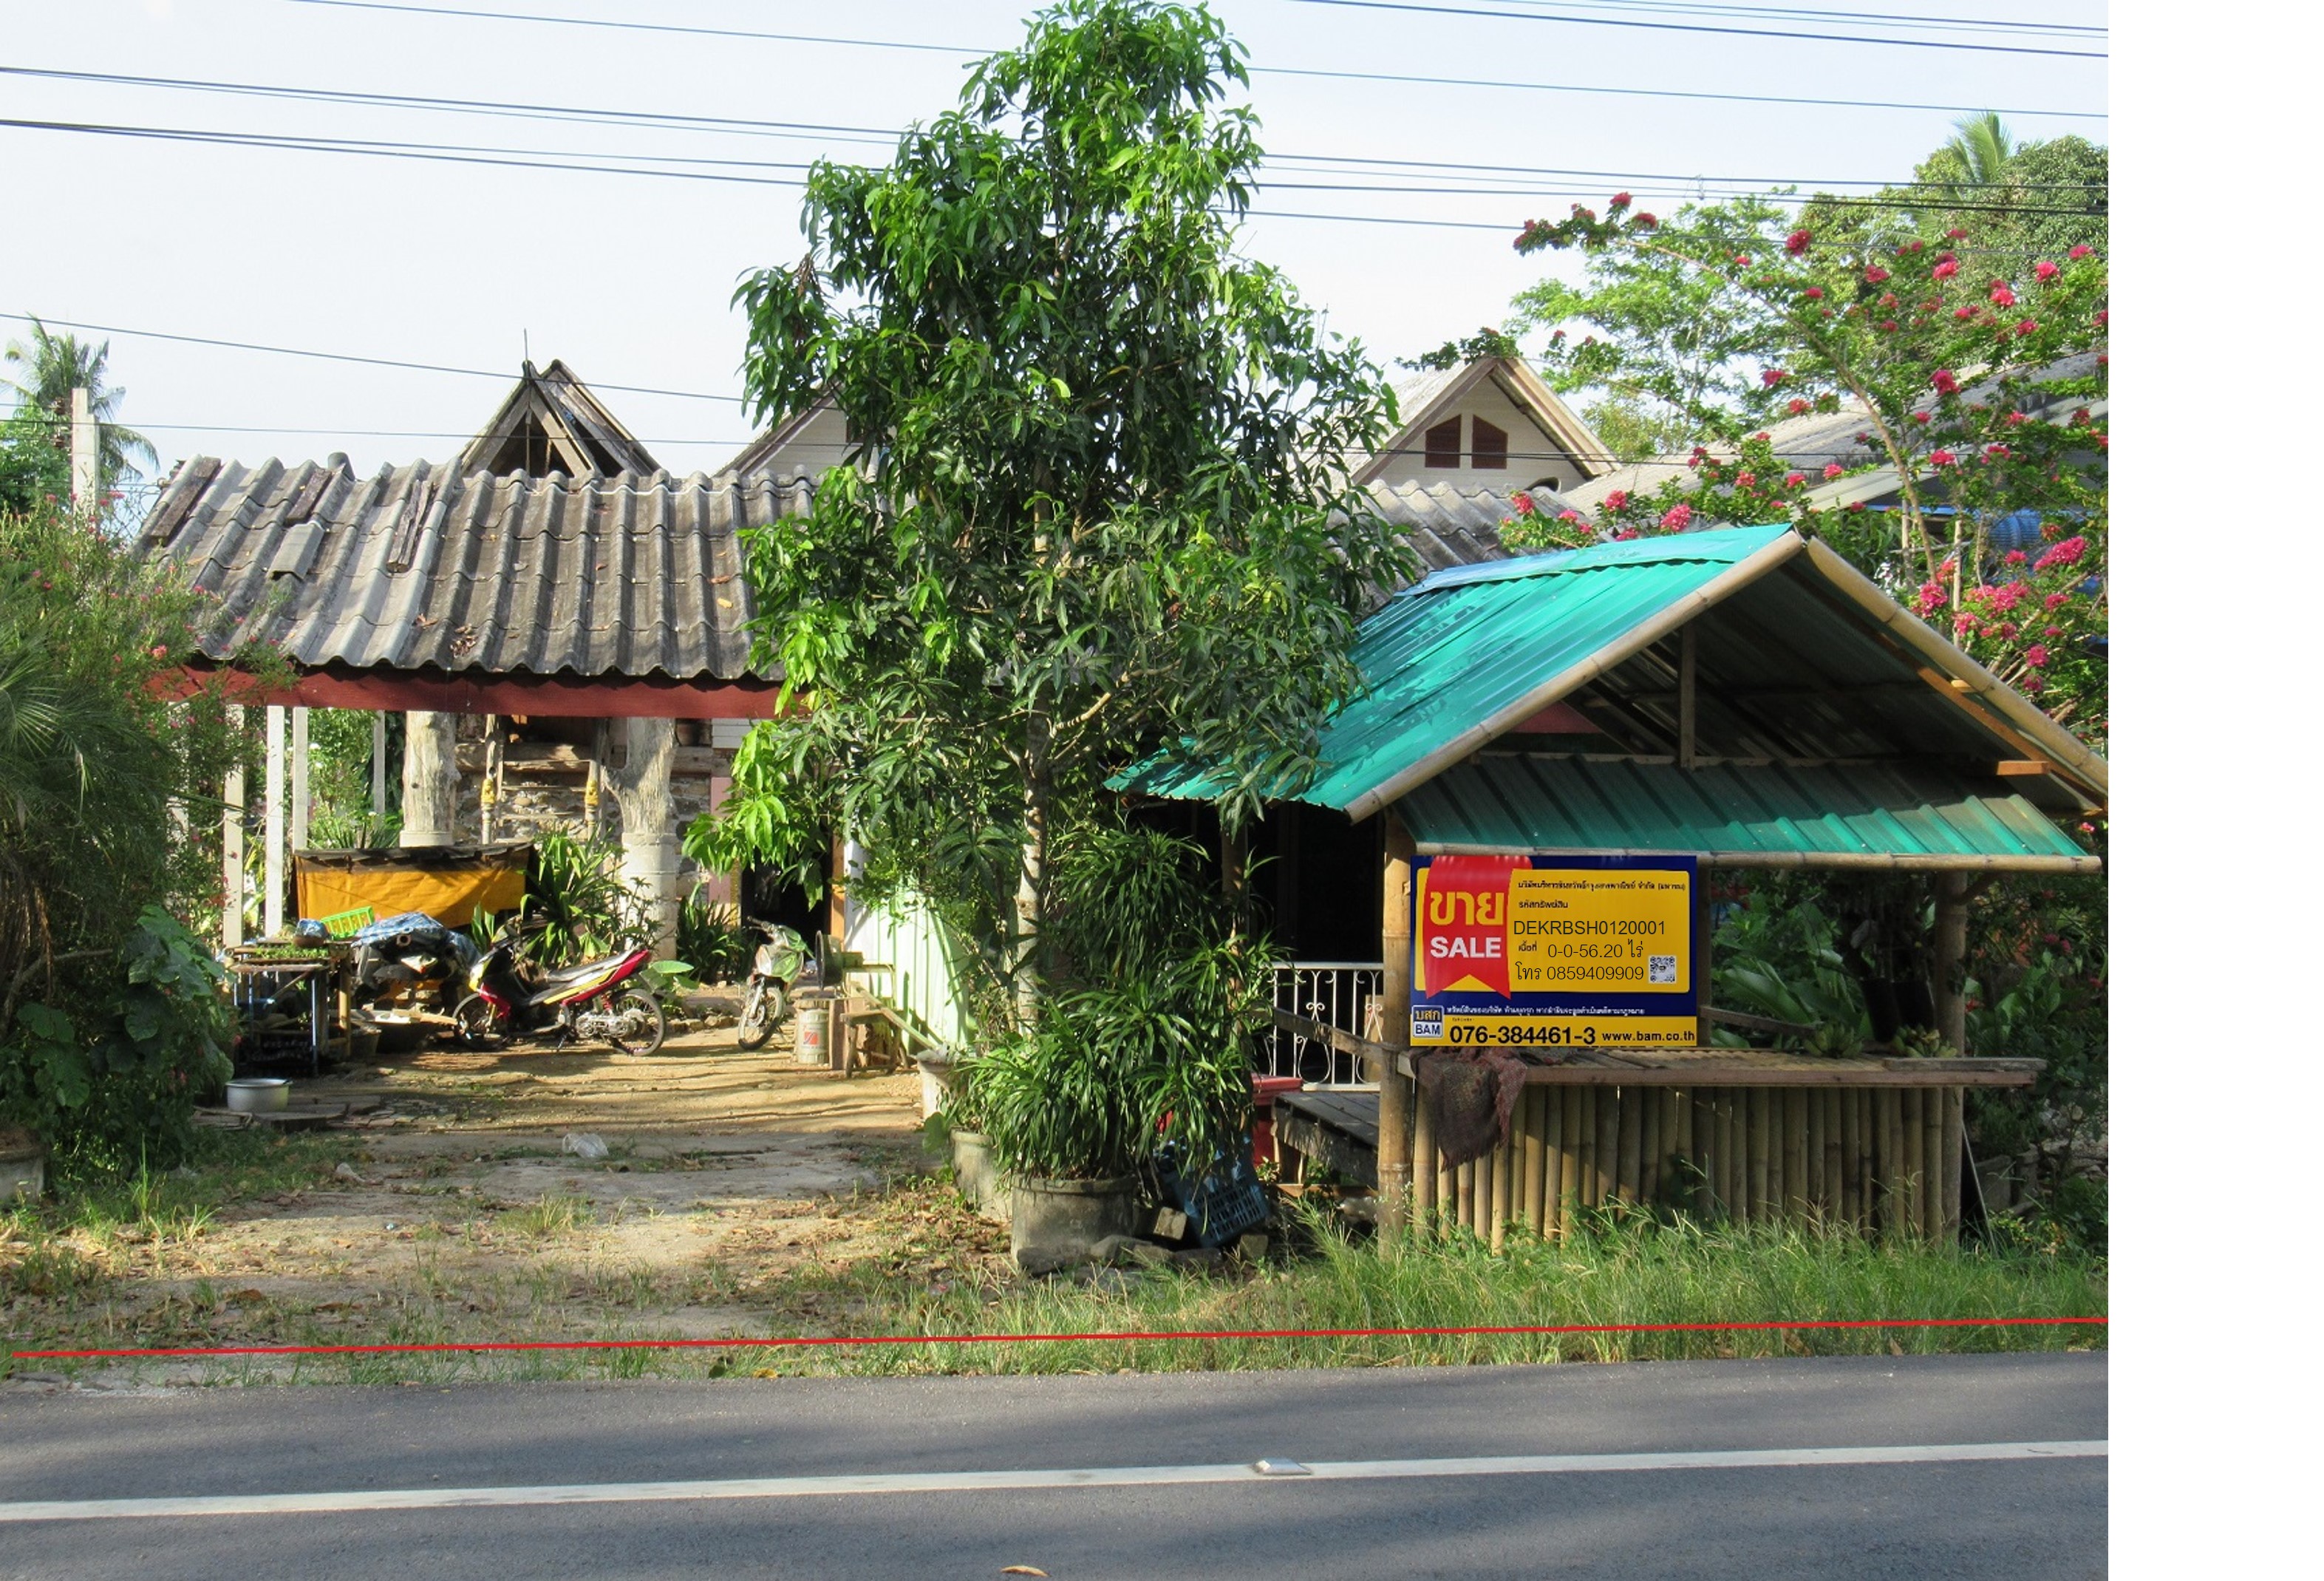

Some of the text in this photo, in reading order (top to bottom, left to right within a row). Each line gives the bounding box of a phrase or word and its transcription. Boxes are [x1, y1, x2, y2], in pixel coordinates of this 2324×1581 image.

[1430, 891, 1505, 926] ขาย
[1519, 899, 1569, 908] รหัสทรัพย์สิน
[1513, 920, 1664, 935] DEKRBSH0120001
[1430, 936, 1502, 959] SALE
[1547, 944, 1623, 958] 0-0-56.20
[1627, 938, 1644, 958] ไร่
[1515, 961, 1644, 980] โทร 0859409909
[1415, 1009, 1440, 1021] บสก
[1415, 1024, 1441, 1036] BAM
[1449, 1025, 1695, 1044] 076-384461-3 www.bam.co.th
